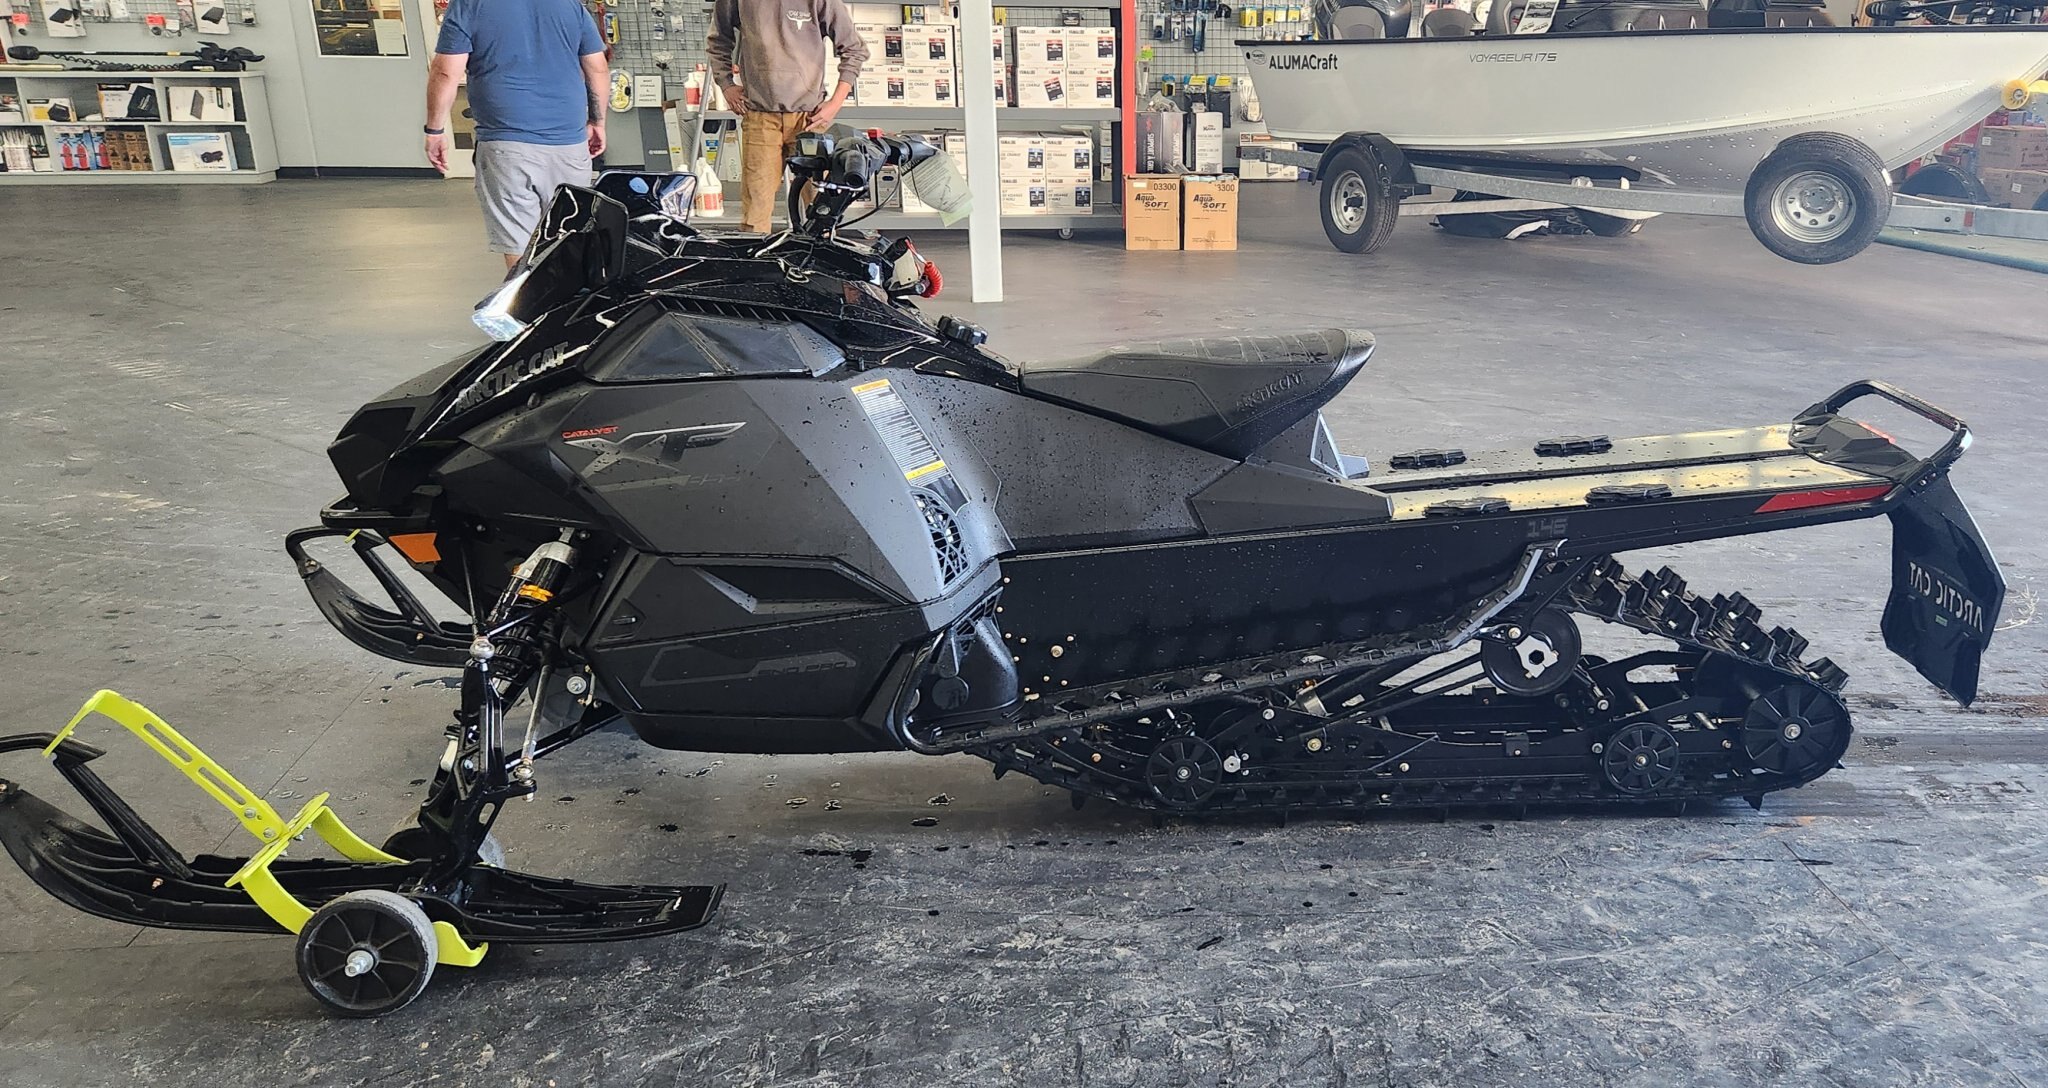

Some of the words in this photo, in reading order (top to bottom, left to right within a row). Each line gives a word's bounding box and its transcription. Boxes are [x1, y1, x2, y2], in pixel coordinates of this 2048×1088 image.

[1269, 53, 1338, 70] ALUMACraft
[1469, 53, 1533, 63] VOYAGEUR
[1534, 52, 1557, 62] 175
[1153, 182, 1177, 191] 03300
[528, 341, 569, 375] CAT
[562, 425, 620, 439] CATALYST
